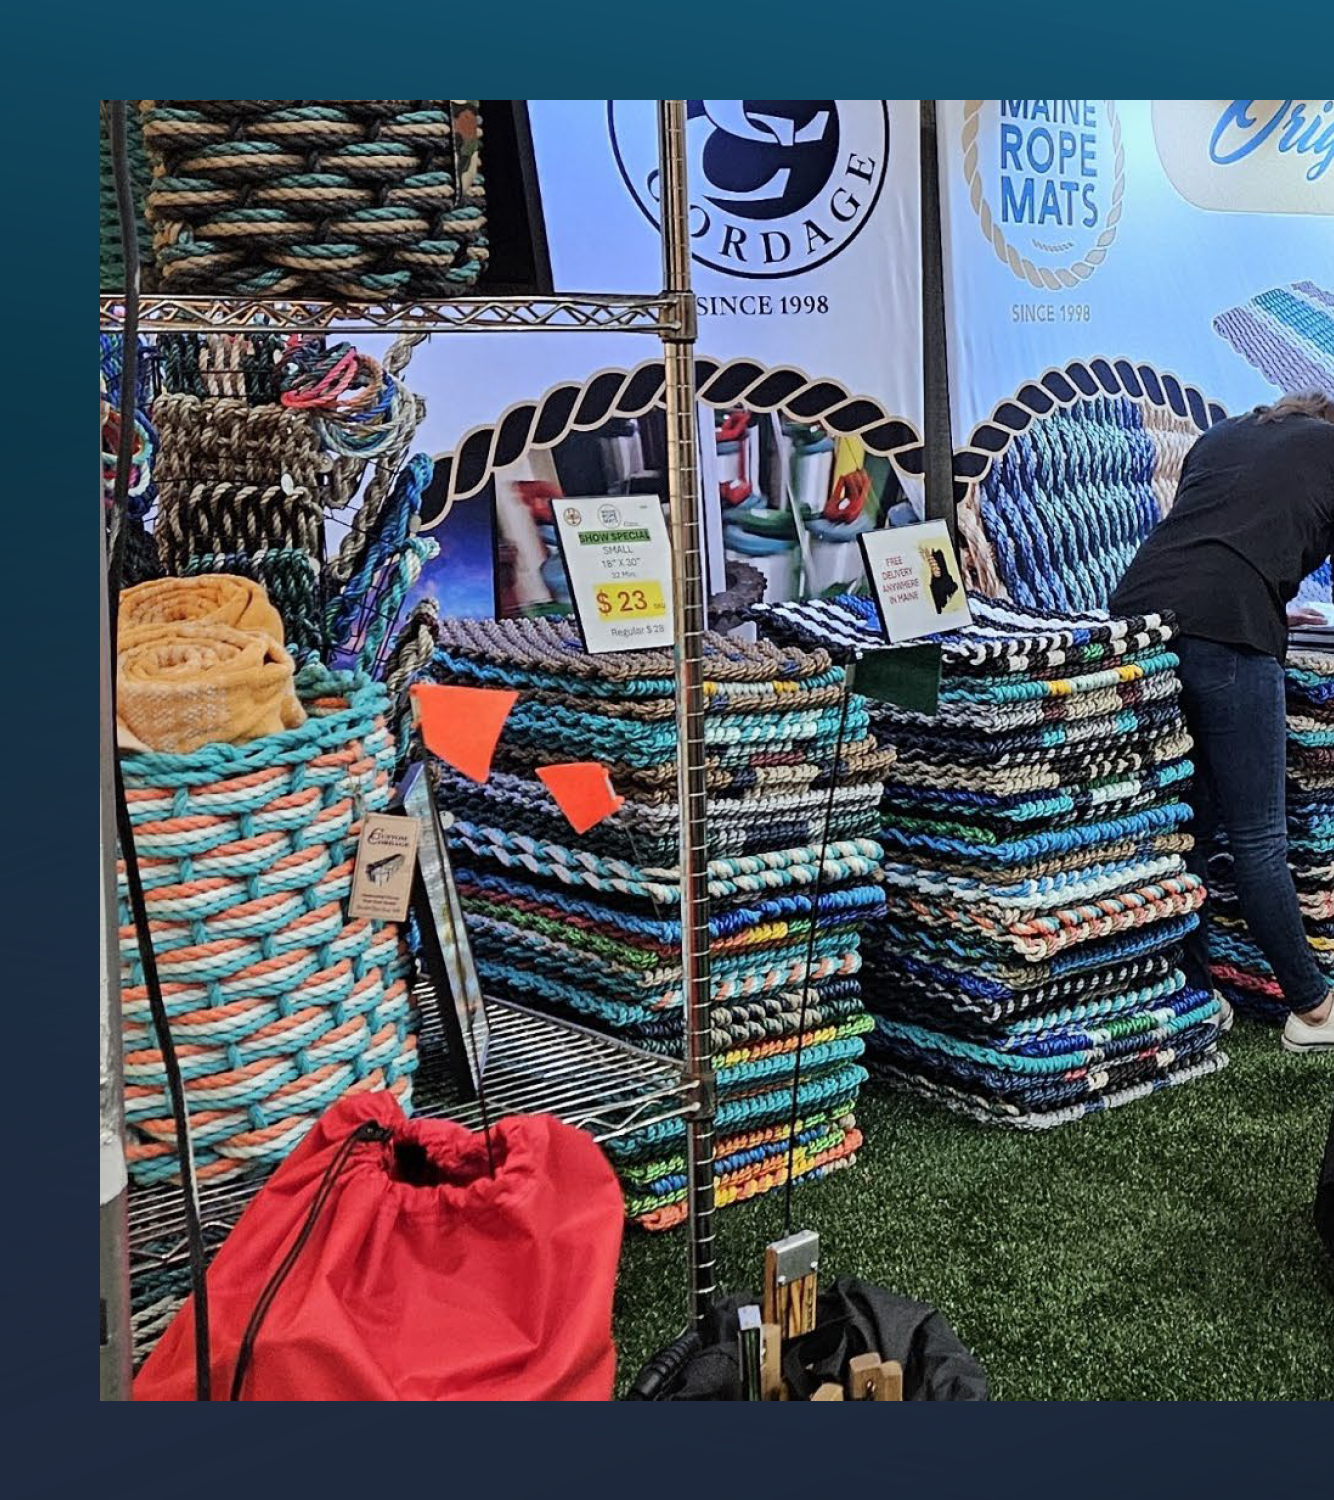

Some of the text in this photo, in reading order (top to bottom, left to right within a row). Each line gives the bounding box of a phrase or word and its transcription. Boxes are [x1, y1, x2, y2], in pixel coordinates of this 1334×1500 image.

[1000, 123, 1098, 178] ROPE
[1000, 176, 1099, 228] MATS
[697, 295, 829, 315] SINCE 1998
[1012, 304, 1091, 323] SINCE 1998
[579, 530, 650, 543] SHOW SPECIAL
[602, 545, 634, 555] SMALL
[885, 556, 903, 567] FREE
[596, 589, 648, 617] $ 23
